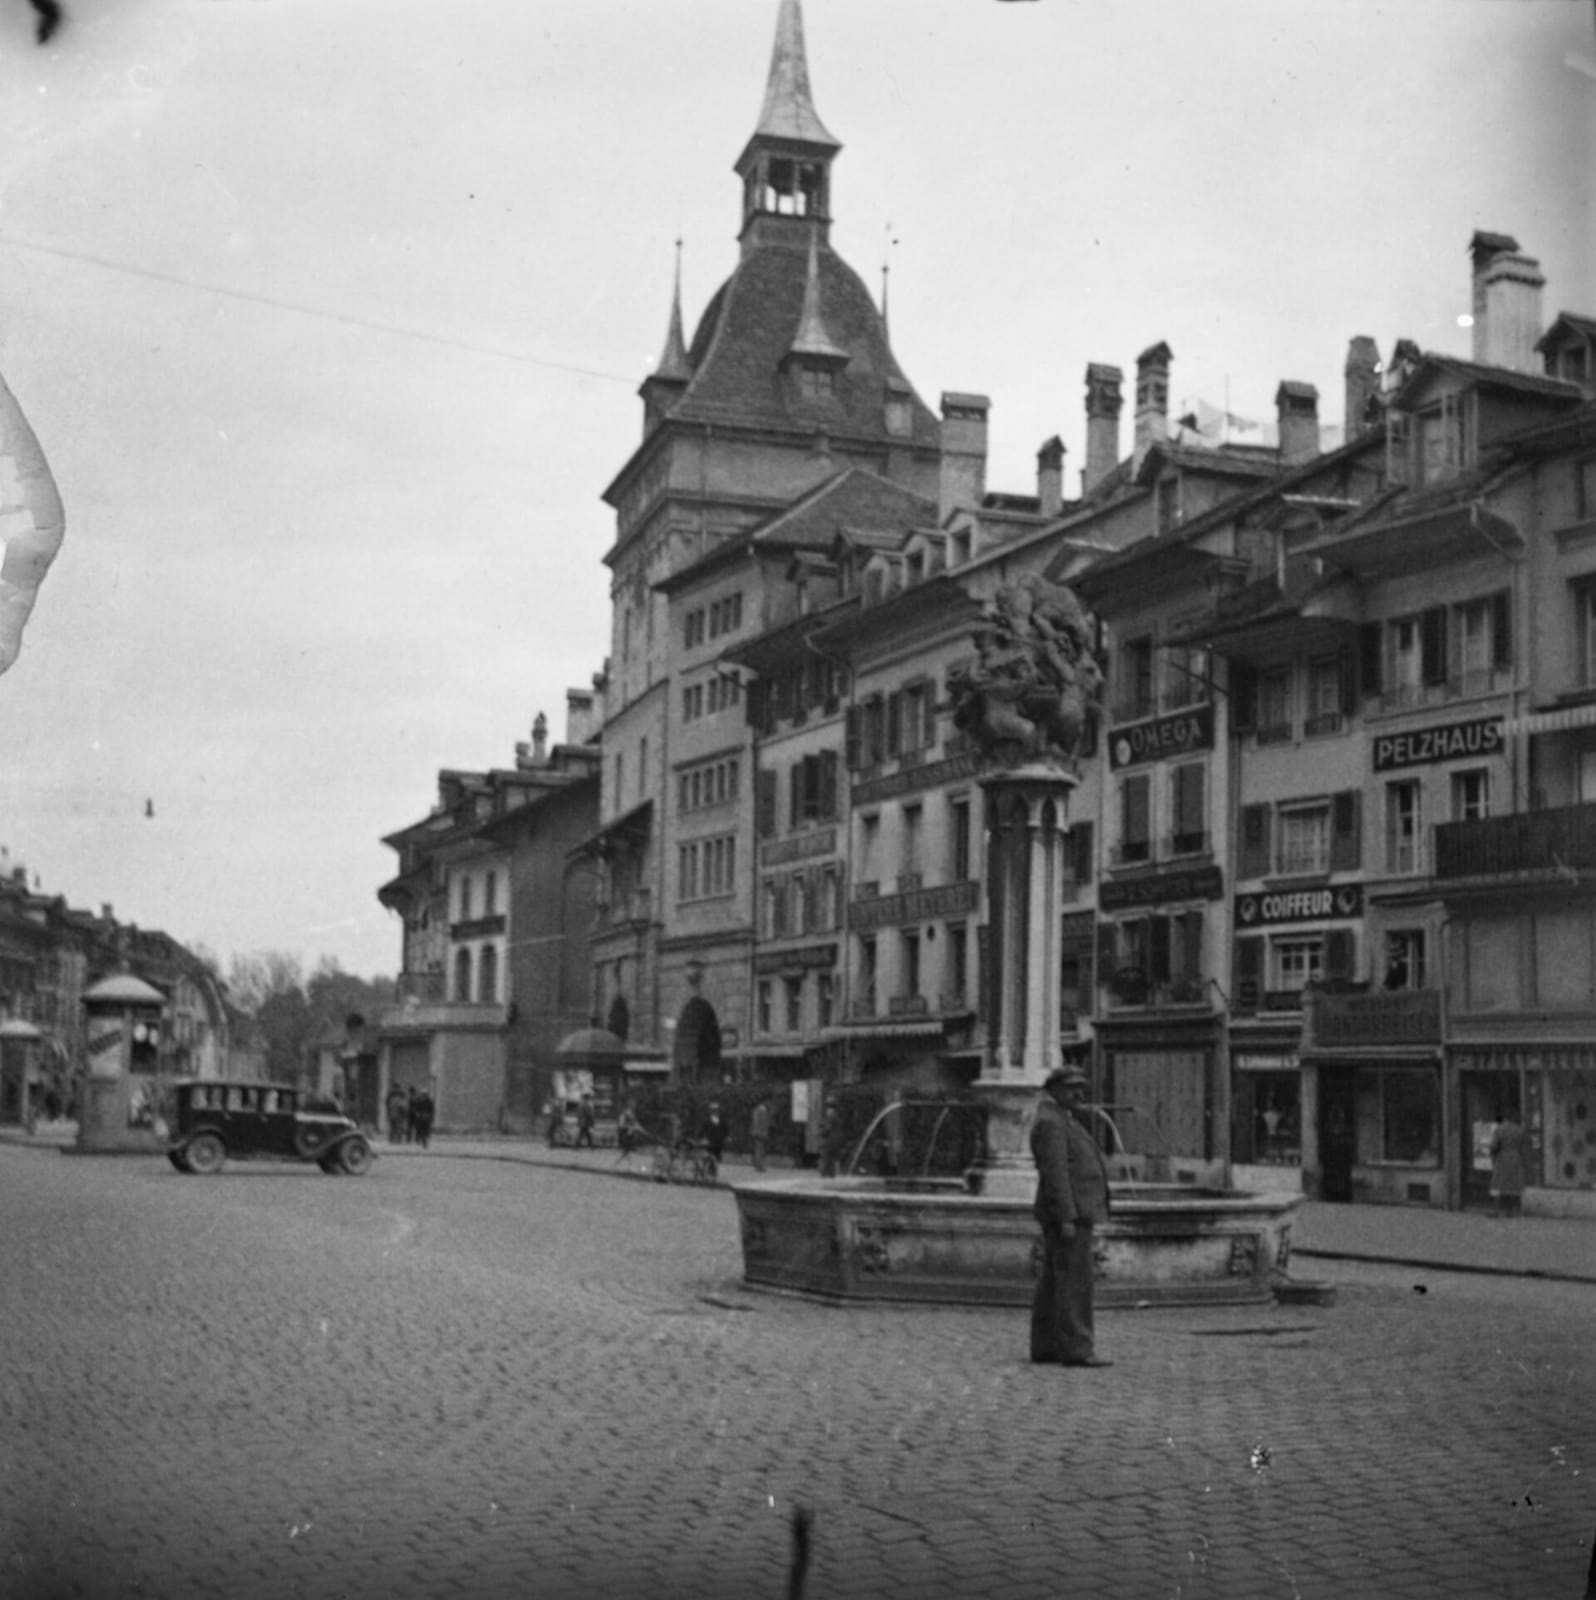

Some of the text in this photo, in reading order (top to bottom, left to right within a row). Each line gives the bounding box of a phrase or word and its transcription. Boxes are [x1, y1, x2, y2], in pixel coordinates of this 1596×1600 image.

[1130, 717, 1203, 753] OMEGA
[1377, 722, 1498, 767] PELZHAUS
[1261, 889, 1334, 921] COIFFEUR
